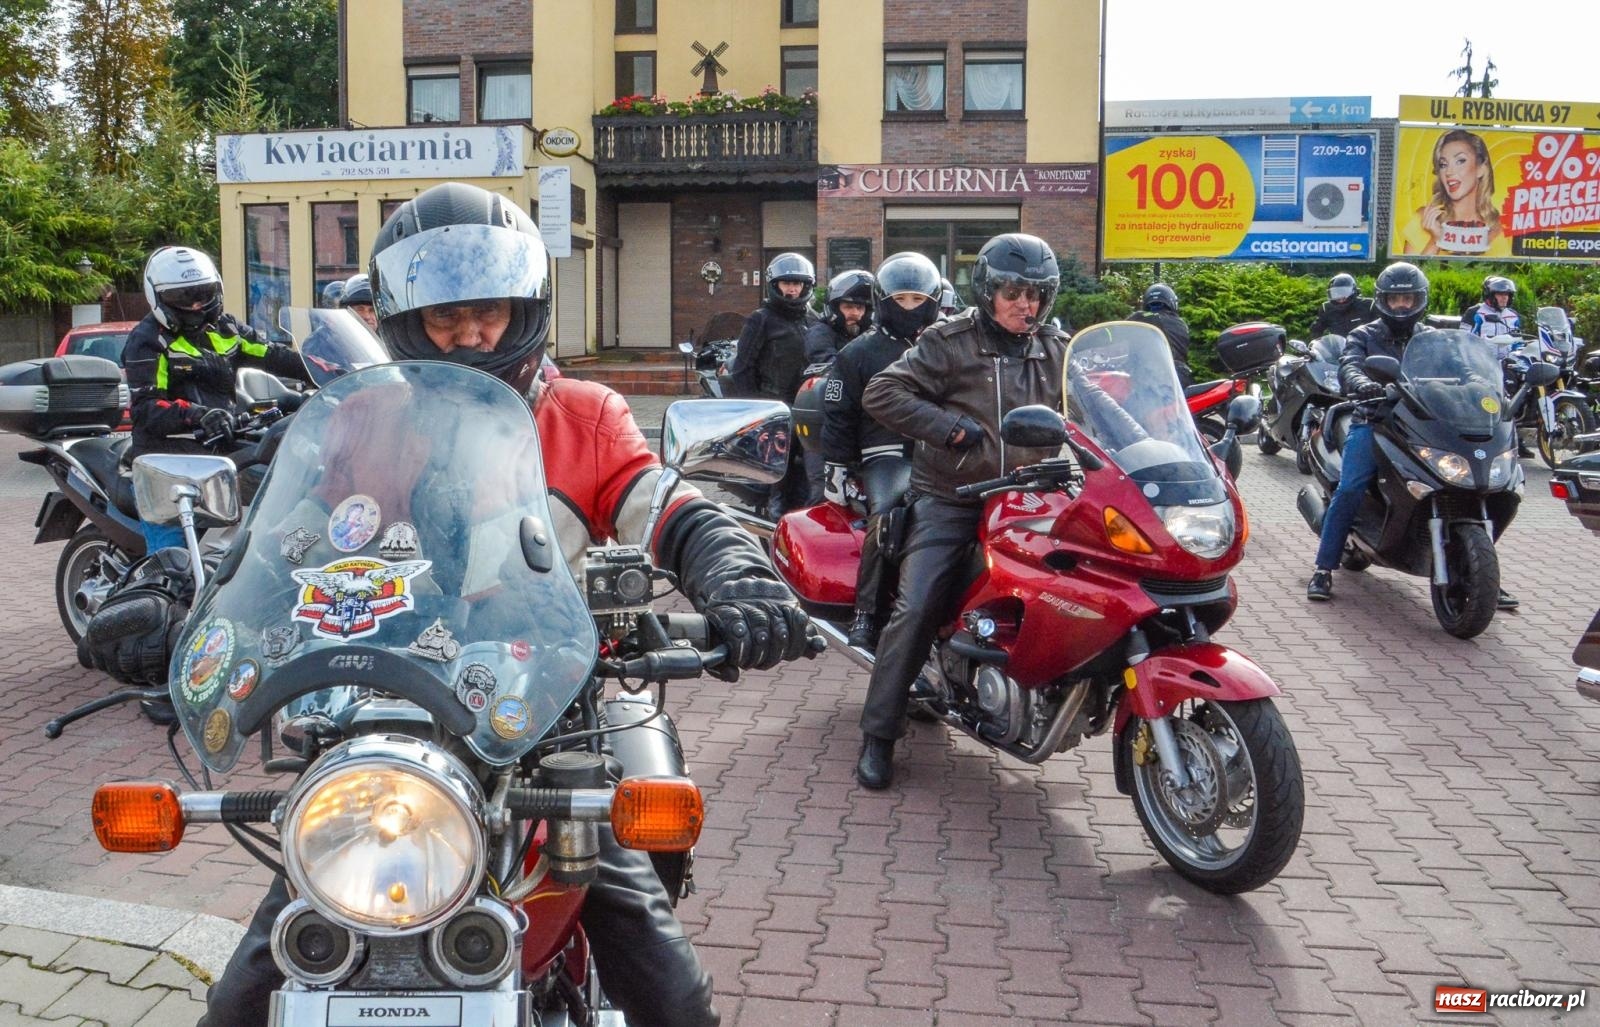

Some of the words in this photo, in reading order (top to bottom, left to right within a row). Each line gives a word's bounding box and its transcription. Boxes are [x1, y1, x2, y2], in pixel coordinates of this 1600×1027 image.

[1326, 103, 1337, 115] 4
[1341, 102, 1366, 116] km
[1430, 99, 1457, 120] UL.
[1462, 101, 1546, 124] RYBNICKA
[1549, 105, 1572, 124] 97
[263, 130, 474, 166] Kwiaciarnia
[545, 136, 576, 146] OKOCIM
[1158, 147, 1197, 162] zyskaj
[340, 167, 356, 177] 792
[357, 166, 374, 176] 828
[375, 166, 390, 176] 591
[858, 167, 1032, 193] CUKIERNIA
[1126, 162, 1226, 210] 100
[1216, 193, 1236, 209] zł
[1512, 179, 1600, 213] PRZECE
[1115, 222, 1126, 231] za
[1128, 220, 1177, 233] instalacje
[1178, 220, 1244, 234] hydrauliczne
[1511, 211, 1537, 231] NA
[1151, 233, 1212, 246] ogrzewanie
[1443, 231, 1457, 243] 21
[1250, 237, 1348, 254] castorama
[825, 379, 843, 402] 23
[1006, 503, 1037, 513] HONDA
[358, 1007, 431, 1018] HONDA
